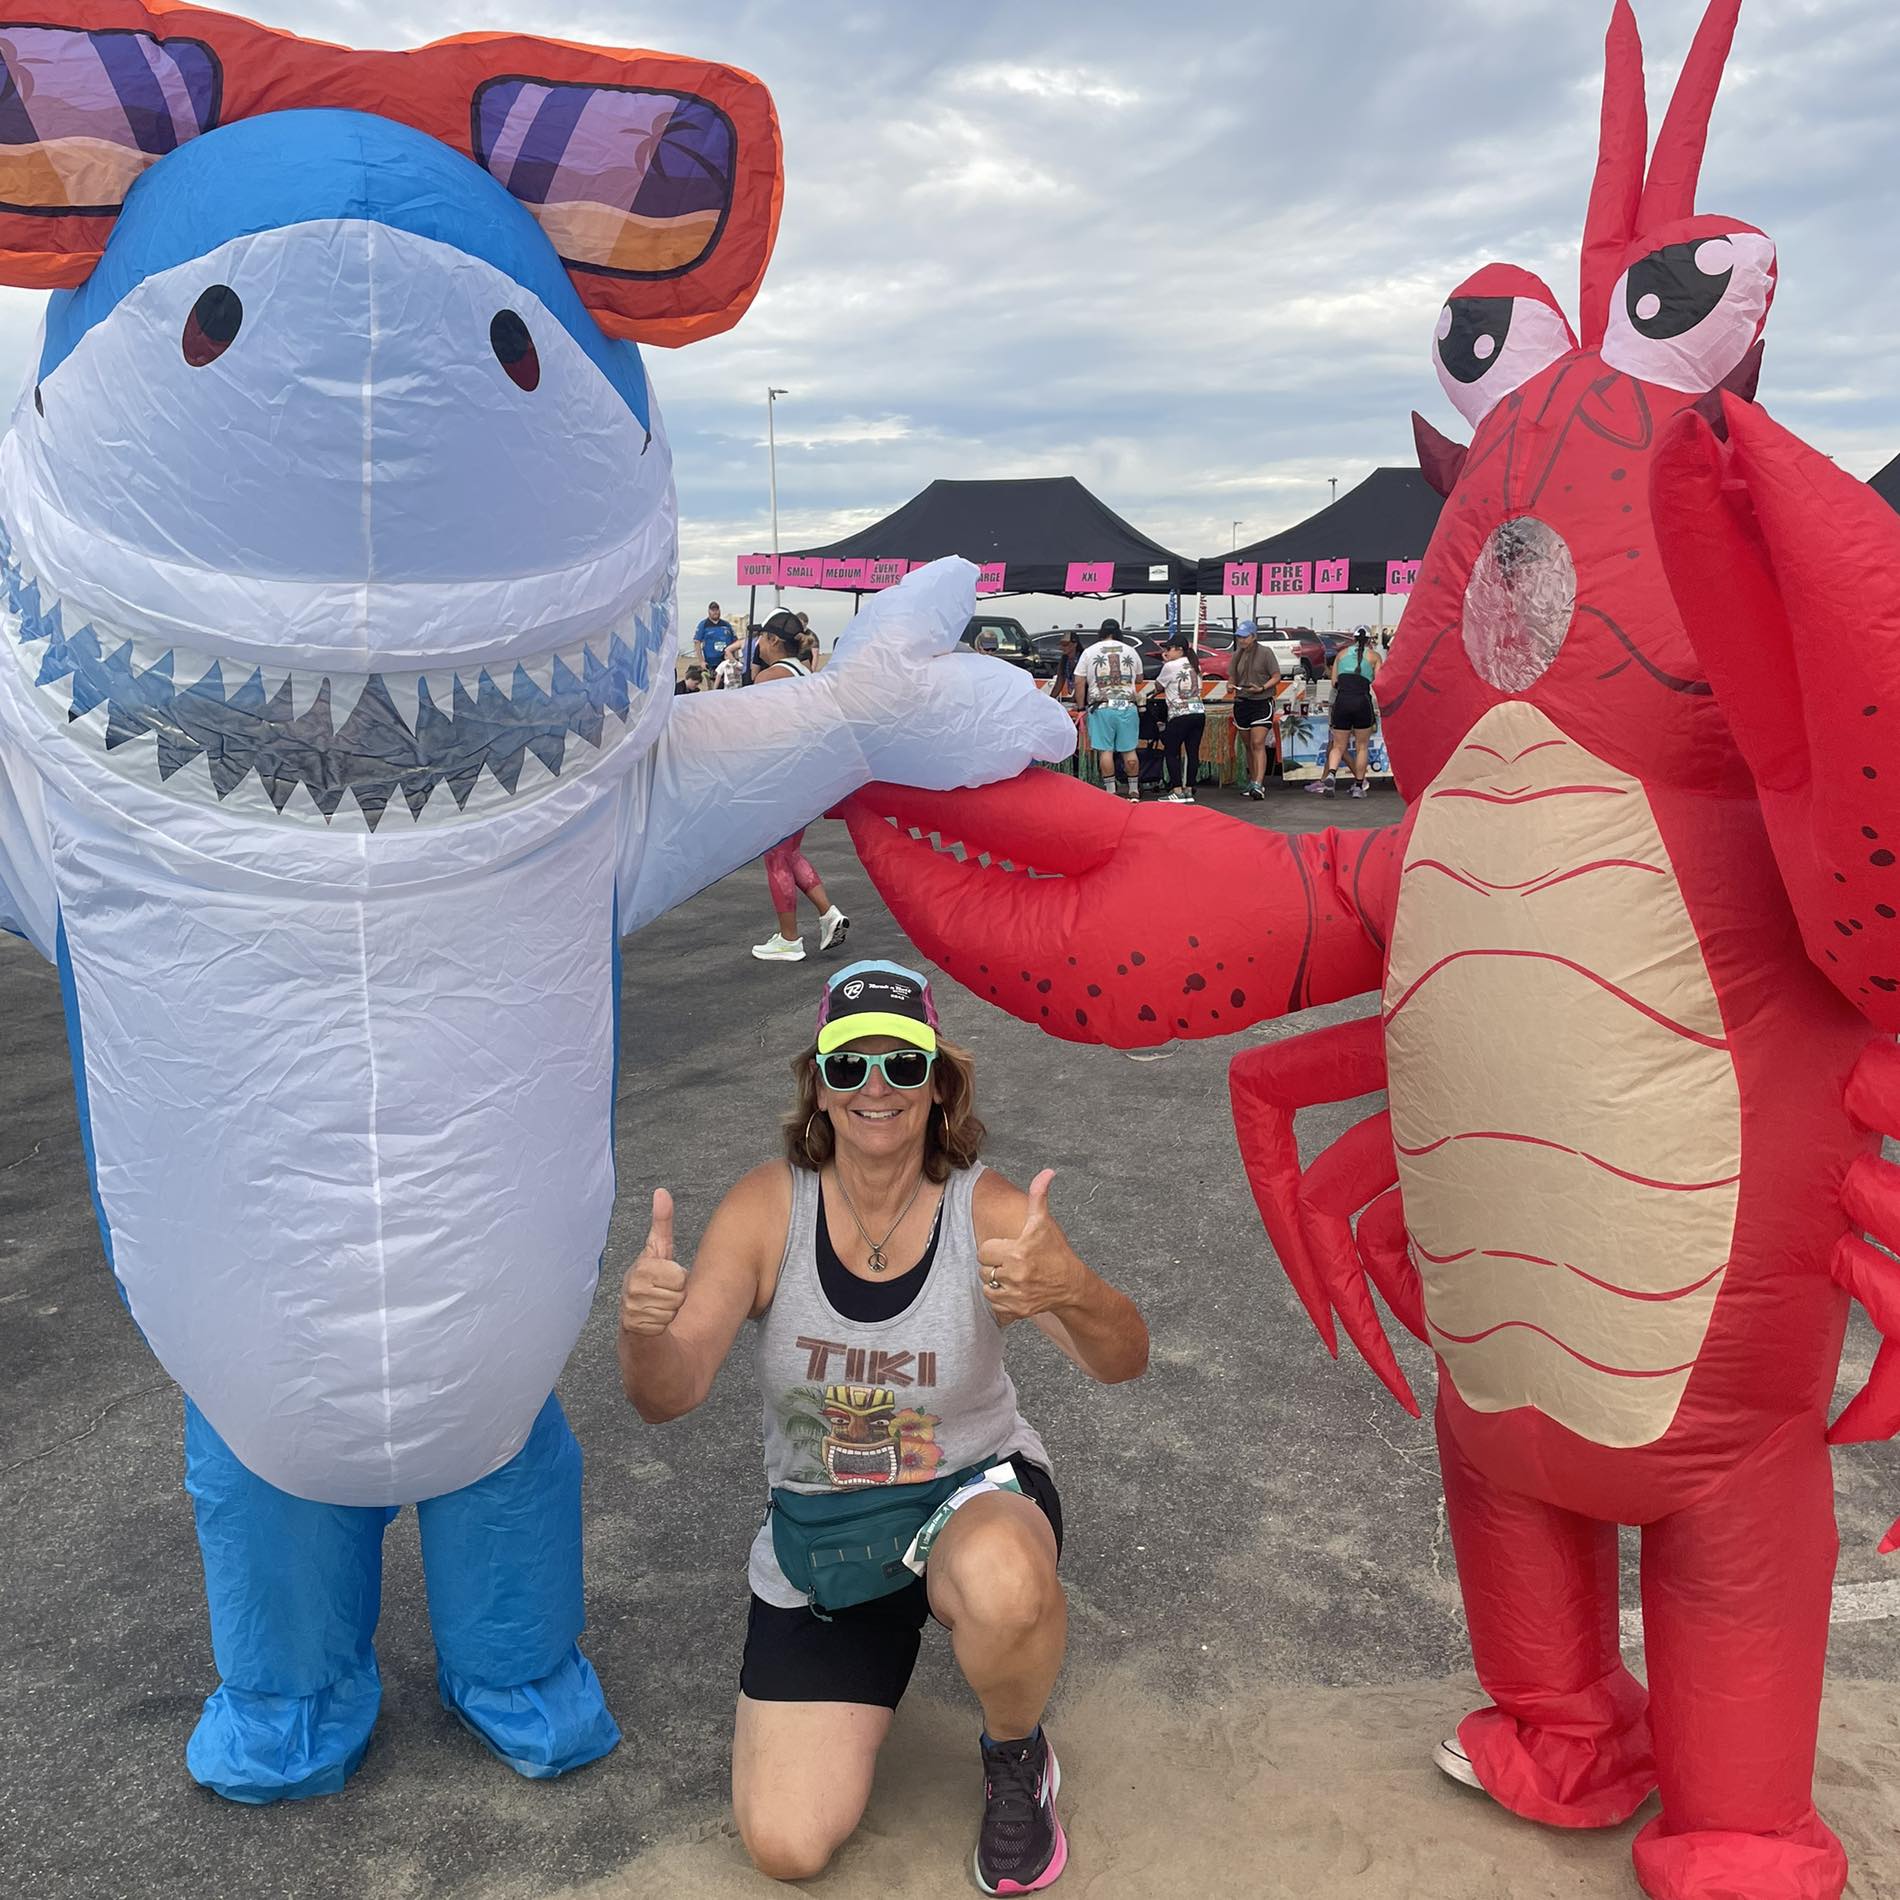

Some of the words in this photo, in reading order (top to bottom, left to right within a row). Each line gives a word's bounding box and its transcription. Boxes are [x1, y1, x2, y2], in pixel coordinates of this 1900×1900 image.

[744, 565, 772, 575] YOUTH
[787, 566, 814, 577] SMALL
[825, 568, 862, 578] MEDIUM
[874, 563, 898, 573] EVENT
[1271, 565, 1303, 578] PRE
[870, 573, 900, 584] SHIRTS
[978, 572, 1000, 582] ARGE
[1081, 571, 1097, 582] XXL
[1231, 571, 1250, 586] 5K
[1320, 567, 1343, 583] A-F
[1391, 569, 1416, 584] G-K
[1270, 579, 1303, 592] REG
[796, 1335, 936, 1387] TIKI
